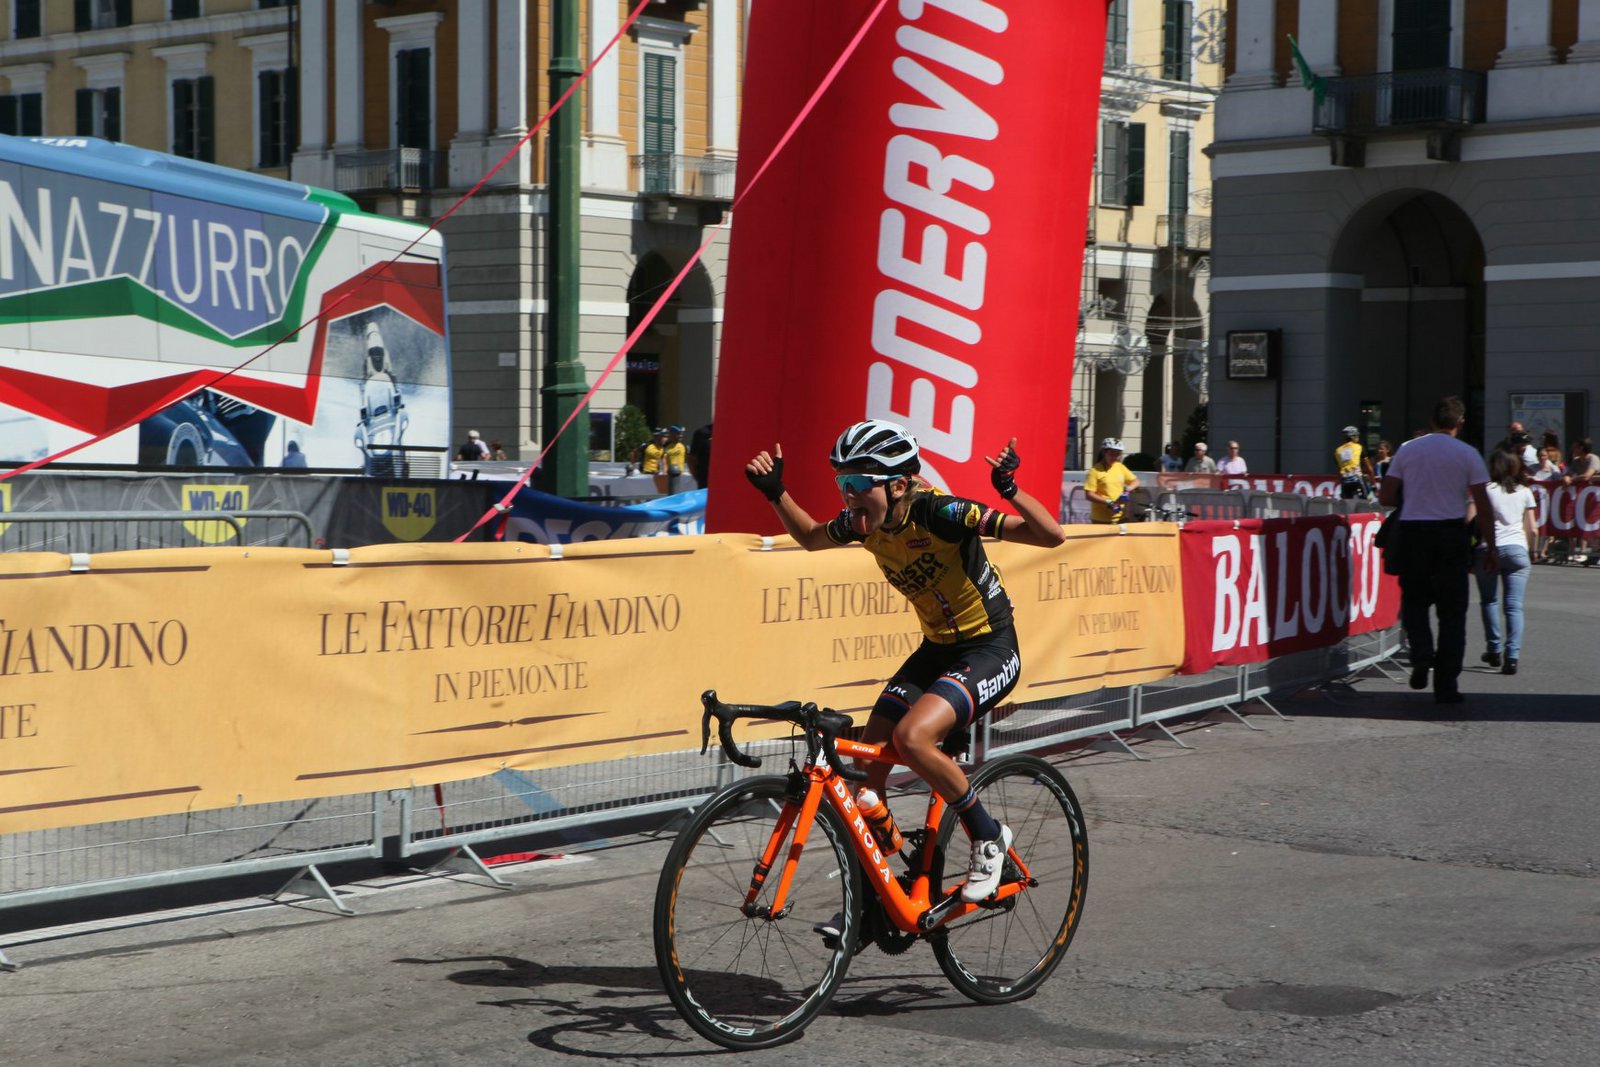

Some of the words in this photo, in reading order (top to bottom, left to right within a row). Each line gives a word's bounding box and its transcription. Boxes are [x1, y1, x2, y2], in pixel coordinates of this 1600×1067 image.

[386, 492, 432, 517] WD-40
[761, 587, 791, 624] LE
[796, 577, 898, 621] FATTORIE
[1038, 570, 1055, 602] LE
[1212, 520, 1381, 653] BALOCCO
[318, 611, 367, 656] LE
[377, 600, 538, 653] FATTORIE
[540, 592, 681, 642] FIANDINO
[832, 637, 850, 663] IN
[434, 672, 460, 704] IN
[467, 661, 589, 701] PIEMONTE
[976, 649, 1020, 706] Santini
[834, 779, 855, 814] DE
[853, 814, 890, 884] ROSA
